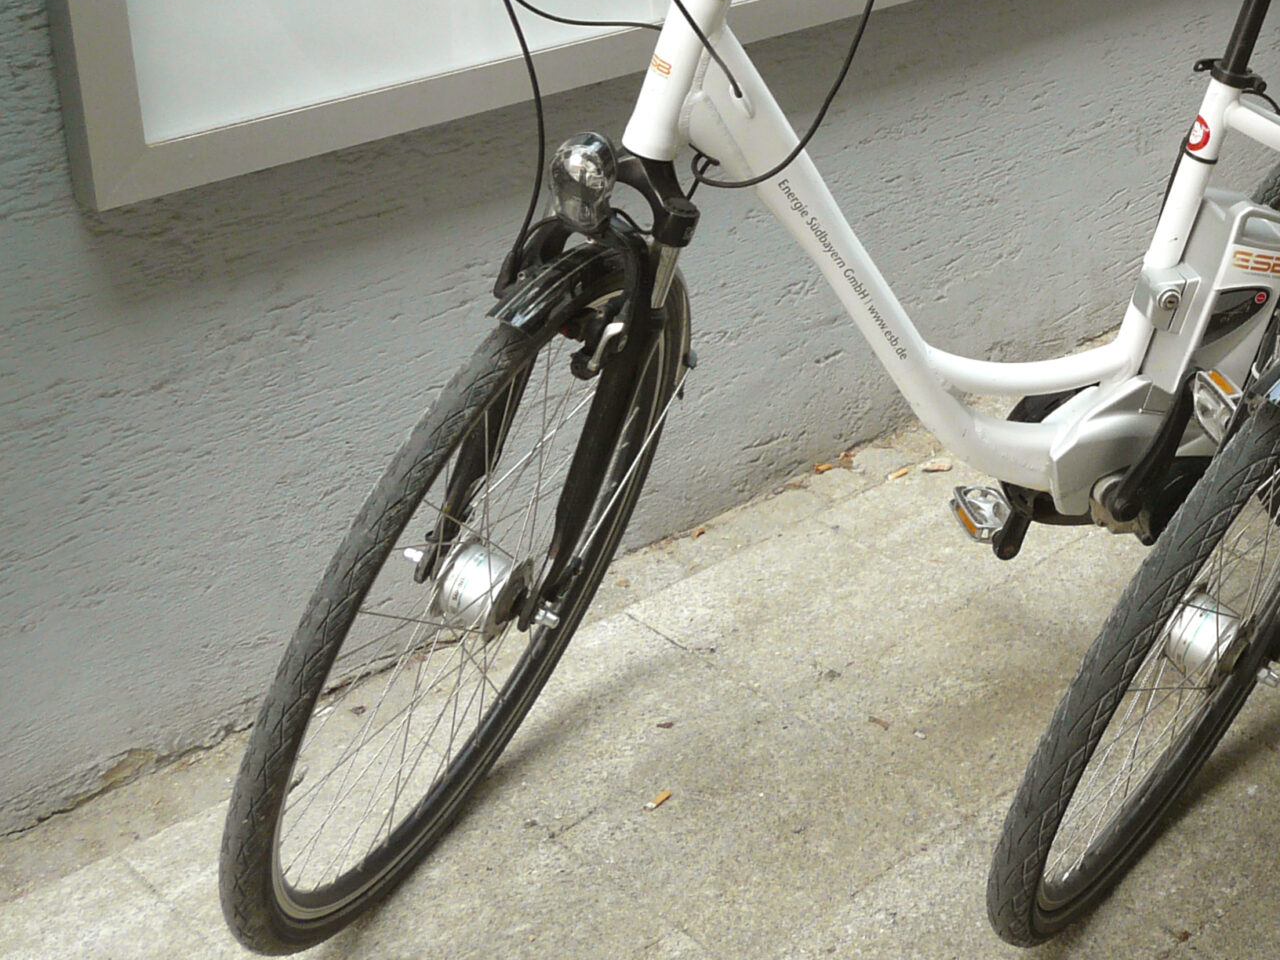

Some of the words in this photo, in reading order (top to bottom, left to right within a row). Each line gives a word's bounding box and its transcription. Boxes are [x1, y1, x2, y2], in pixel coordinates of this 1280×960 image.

[778, 179, 809, 218] Energie
[806, 216, 846, 269] Südbayern
[843, 268, 870, 300] GmbH
[866, 304, 908, 360] www.esb.de
